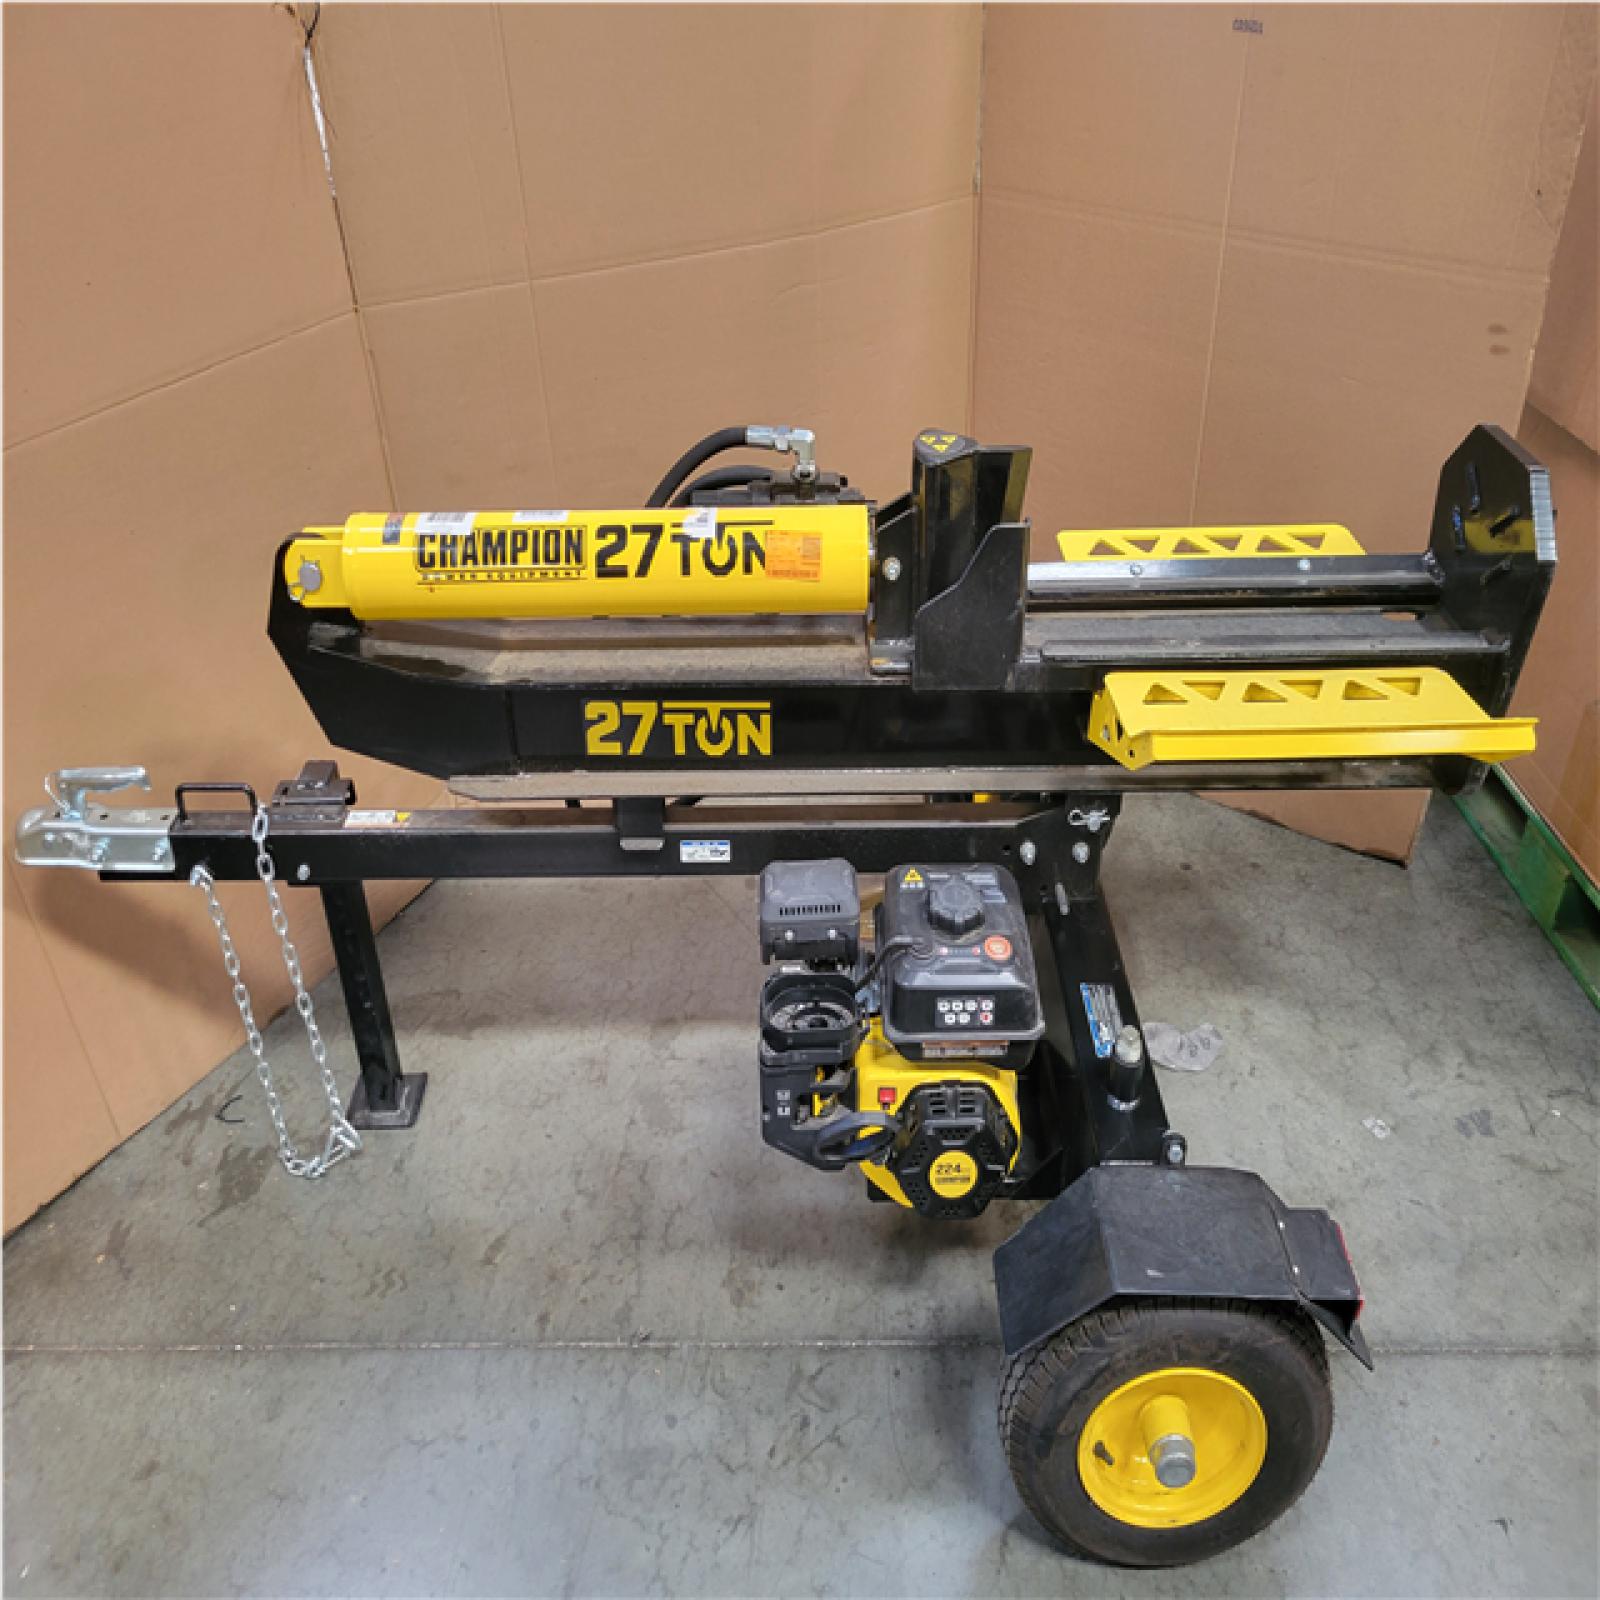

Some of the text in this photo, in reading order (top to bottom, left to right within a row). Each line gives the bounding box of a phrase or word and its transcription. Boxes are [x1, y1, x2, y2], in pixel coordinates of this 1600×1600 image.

[418, 527, 584, 569] CHAMPION
[595, 522, 664, 579] 27
[584, 701, 771, 756] 27 TON
